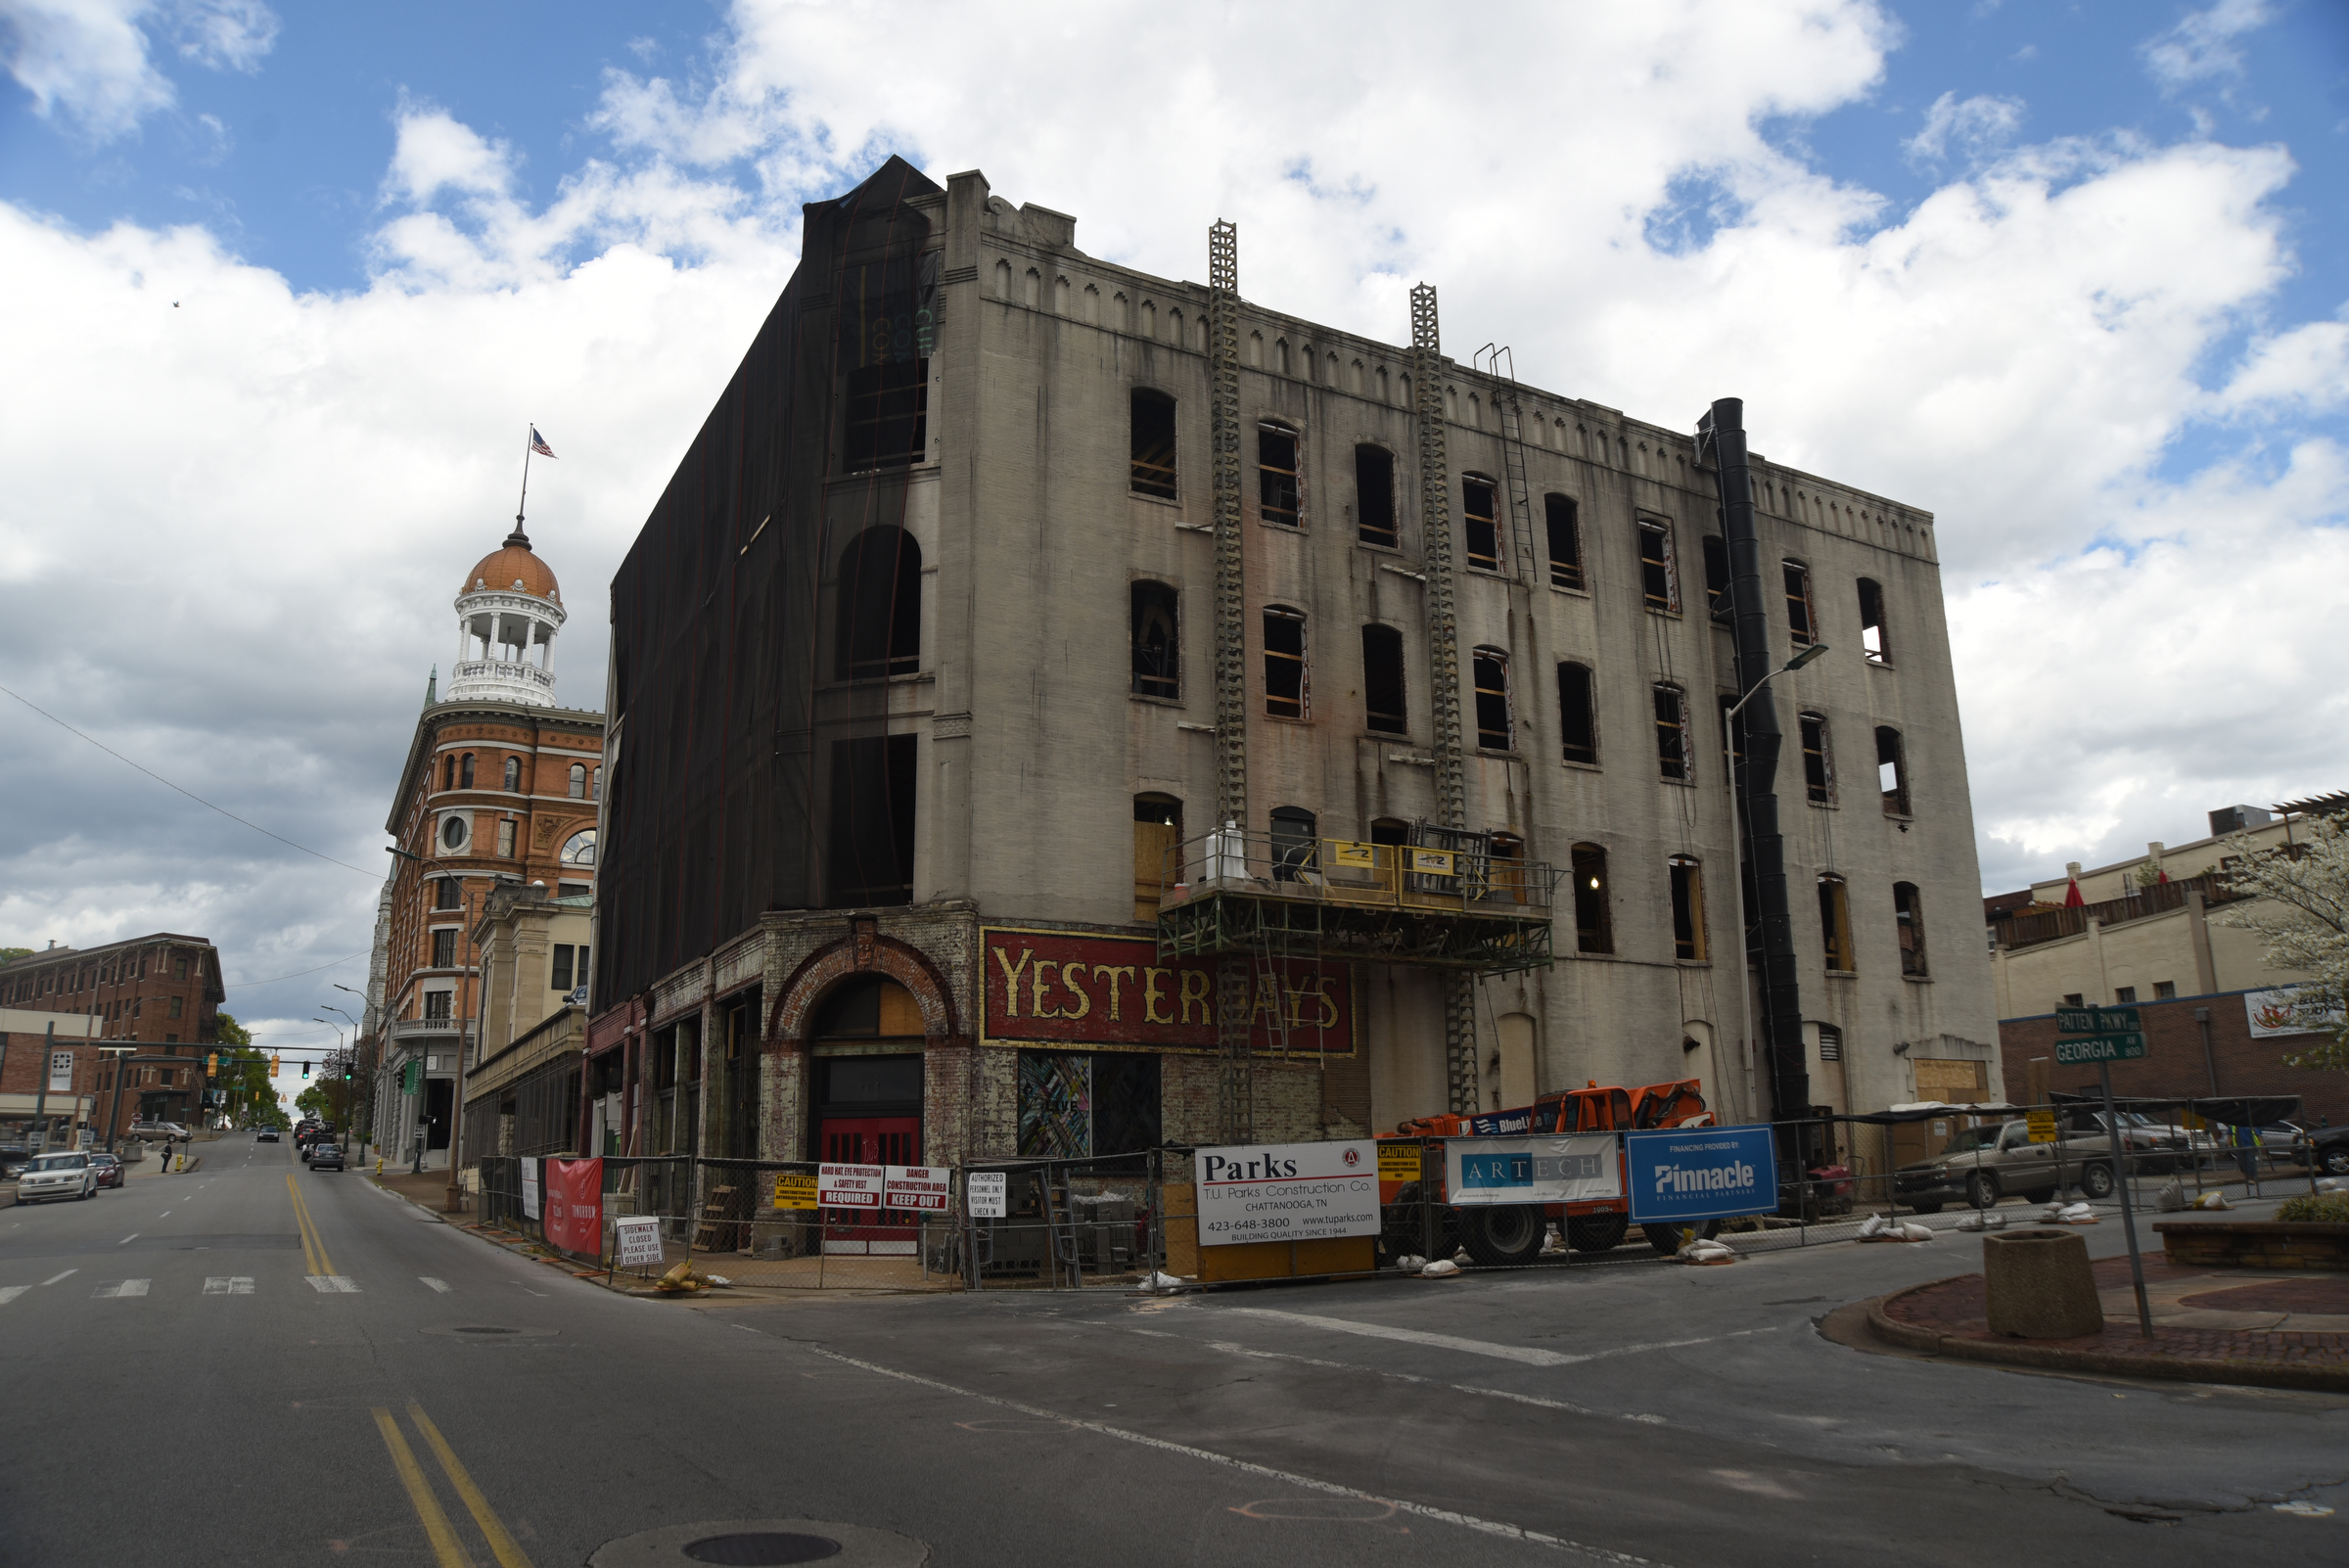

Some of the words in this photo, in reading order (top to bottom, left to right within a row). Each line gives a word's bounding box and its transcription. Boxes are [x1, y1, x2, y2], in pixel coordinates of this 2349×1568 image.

[2057, 1013, 2094, 1030] PATTEN
[2099, 1013, 2127, 1030] PKWY
[2126, 1036, 2137, 1045] AV
[2056, 1040, 2117, 1061] GEORGIA
[2125, 1046, 2141, 1057] 800
[1379, 1147, 1419, 1157] CAUTION
[1670, 1144, 1703, 1153] FINANCING
[1705, 1142, 1730, 1151] PROVIDED
[821, 1167, 834, 1175] HARD
[853, 1168, 881, 1177] PROTECTION
[1202, 1153, 1297, 1181] Parks
[1469, 1157, 1596, 1178] ARTECH
[906, 1169, 929, 1178] DANGER
[1655, 1160, 1754, 1193] Pinnacle
[778, 1176, 818, 1188] CAUTION
[838, 1179, 854, 1188] SAFETY
[855, 1180, 867, 1189] VEST
[887, 1180, 931, 1191] CONSTRUCTION
[932, 1183, 946, 1192] AREA
[970, 1185, 990, 1193] PERSONNEL
[1204, 1189, 1222, 1200] T.U.
[1228, 1186, 1260, 1199] Parks
[1266, 1181, 1345, 1197] Construction
[1350, 1180, 1371, 1192] Co.
[1657, 1193, 1710, 1201] FINANCIAL
[1715, 1189, 1755, 1197] PARTNERS
[826, 1192, 873, 1204] REQUIRED
[892, 1193, 917, 1205] KEEP
[919, 1195, 940, 1207] OUT
[971, 1196, 987, 1204] VISITOR
[989, 1197, 1001, 1205] MUST
[974, 1207, 989, 1216] CHECK
[1245, 1200, 1314, 1212] CHATTANOOGA,
[1316, 1199, 1327, 1207] TN
[572, 1205, 596, 1219] TOMORROW
[1208, 1218, 1290, 1232] 423-648-3800
[1302, 1213, 1373, 1225] www.tuparks.com
[624, 1225, 654, 1235] SIDEWALK
[1232, 1232, 1269, 1241] BUILDING
[1270, 1230, 1303, 1240] QUALITY
[1305, 1229, 1327, 1237] SINCE
[629, 1235, 652, 1244] CLOSED
[623, 1245, 645, 1254] PLEASE
[625, 1255, 645, 1264] OTHER
